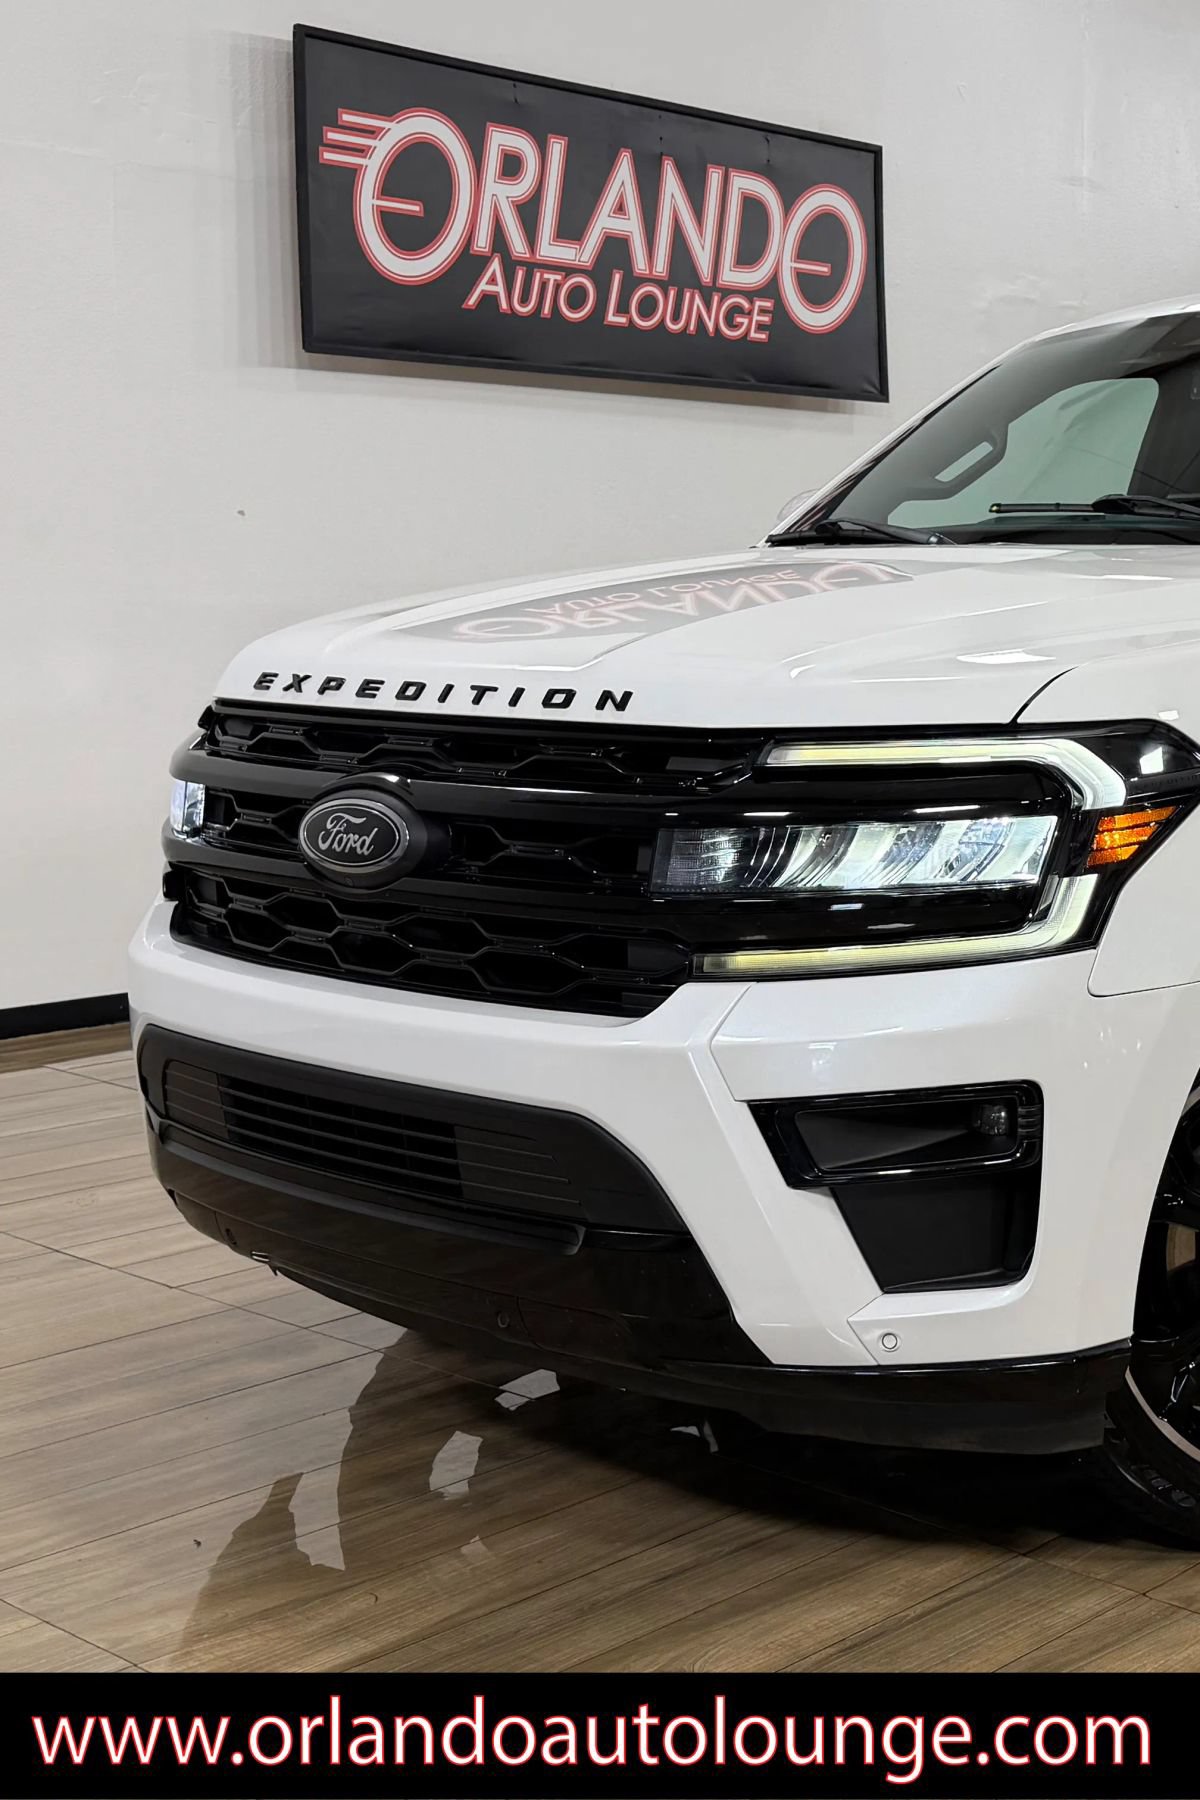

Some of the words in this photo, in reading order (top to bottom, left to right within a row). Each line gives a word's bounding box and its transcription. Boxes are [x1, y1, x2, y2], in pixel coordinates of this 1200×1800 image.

[352, 107, 868, 334] ORLANDO
[461, 253, 598, 320] AUTO
[603, 269, 774, 343] LOUNGE
[252, 671, 634, 712] EXPEDITION
[318, 812, 379, 855] Ford
